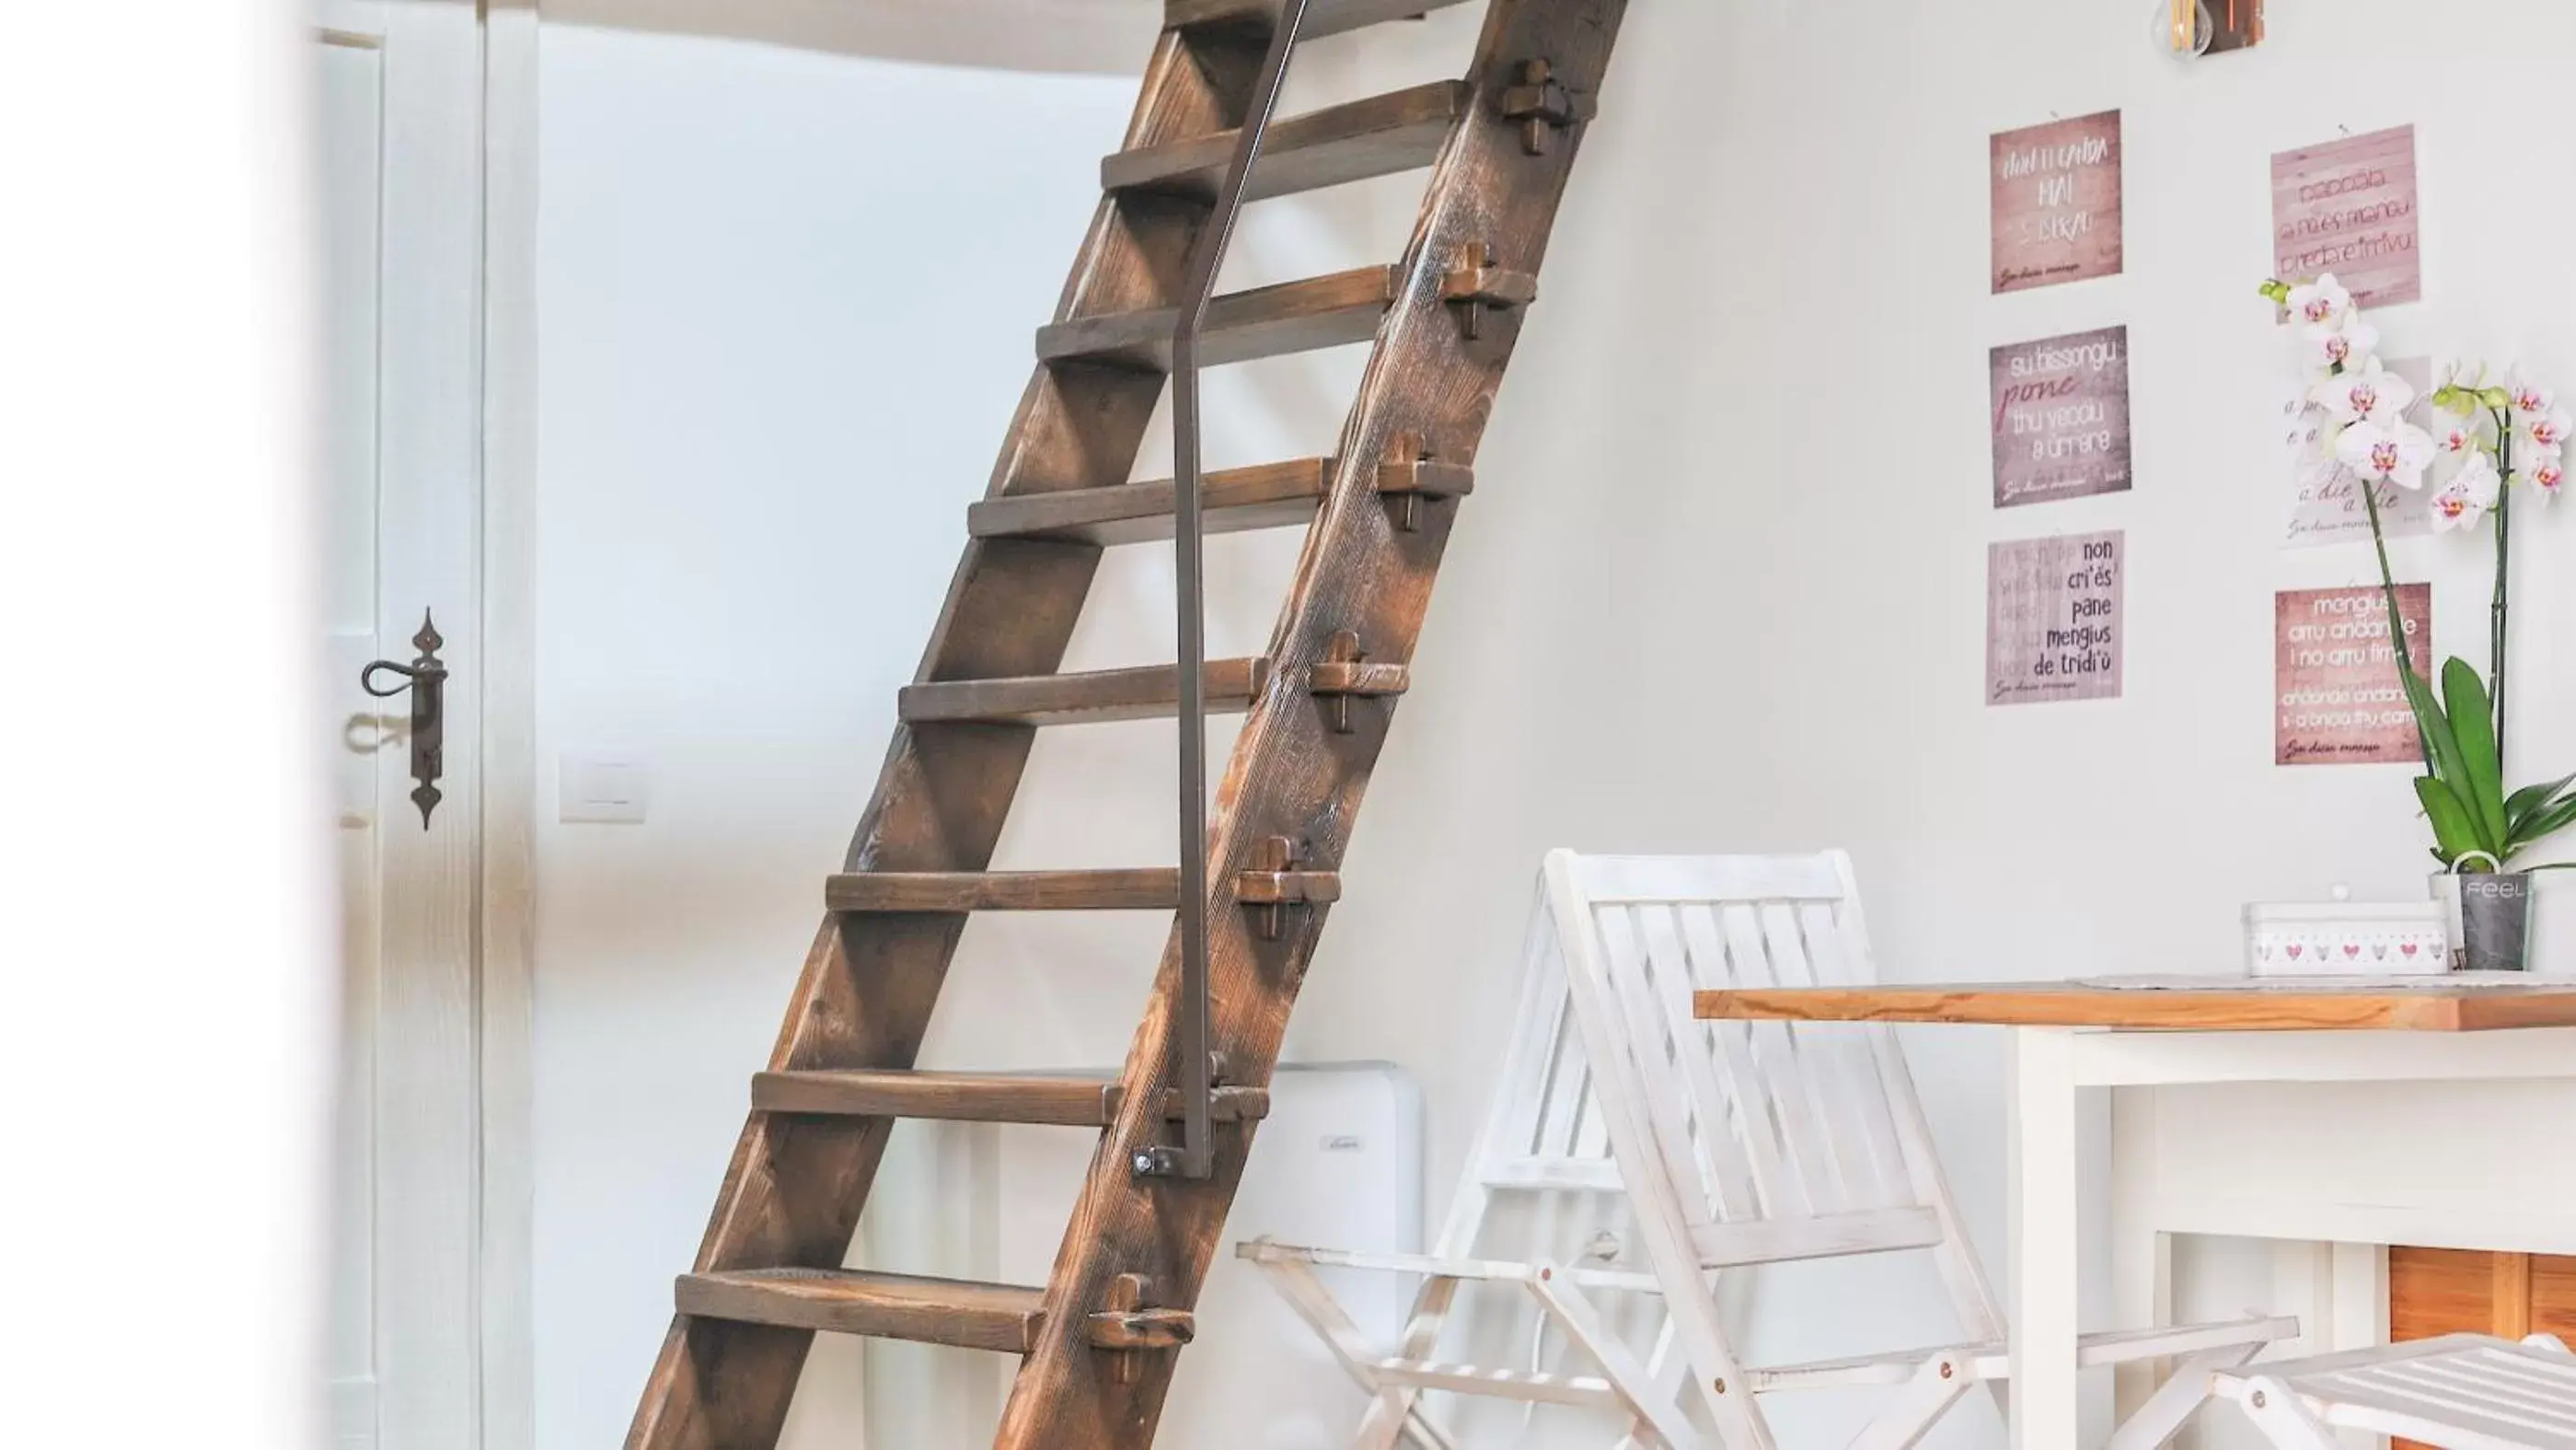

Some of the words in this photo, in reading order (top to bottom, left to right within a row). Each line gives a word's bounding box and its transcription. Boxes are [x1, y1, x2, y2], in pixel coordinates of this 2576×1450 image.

[2084, 540, 2113, 561] non
[2072, 597, 2112, 625] pane
[2046, 624, 2111, 650] mengius
[2329, 617, 2418, 640] andane
[2033, 653, 2054, 676] de
